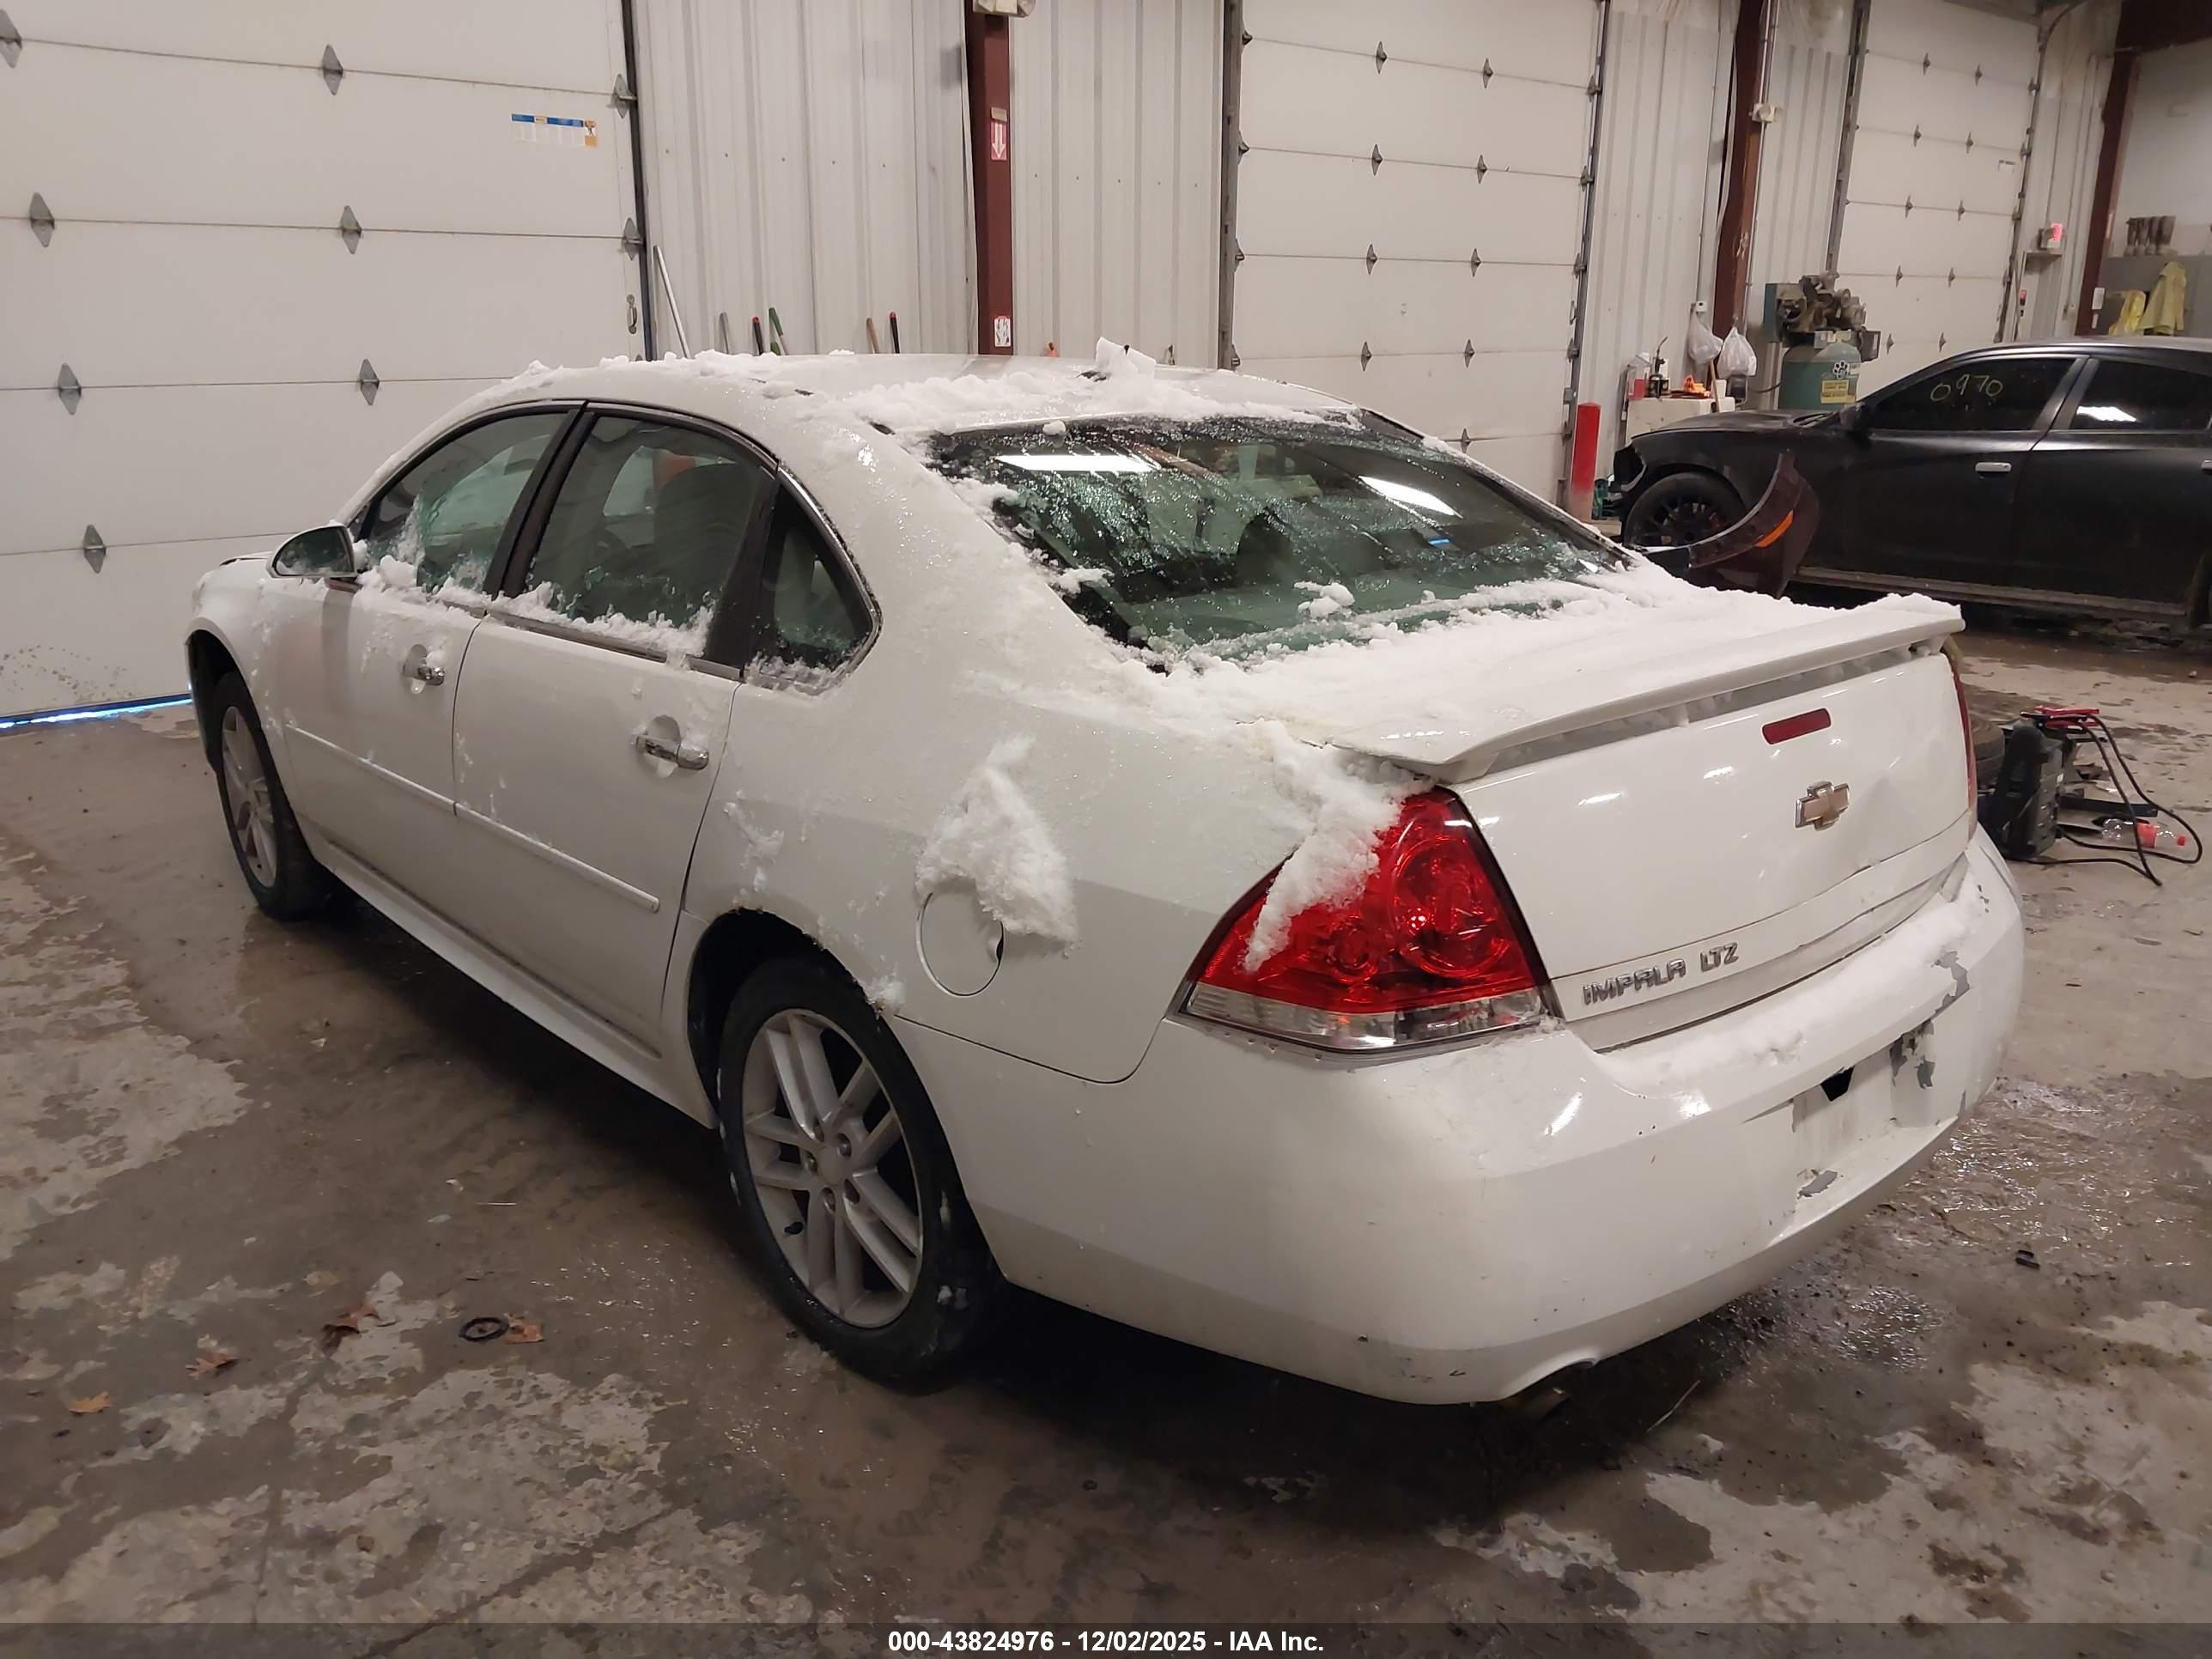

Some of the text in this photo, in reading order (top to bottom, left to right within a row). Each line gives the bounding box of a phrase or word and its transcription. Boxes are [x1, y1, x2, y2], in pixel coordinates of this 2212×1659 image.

[1929, 374, 2004, 402] 0970
[1582, 942, 1740, 1006] IMPALA LTZ
